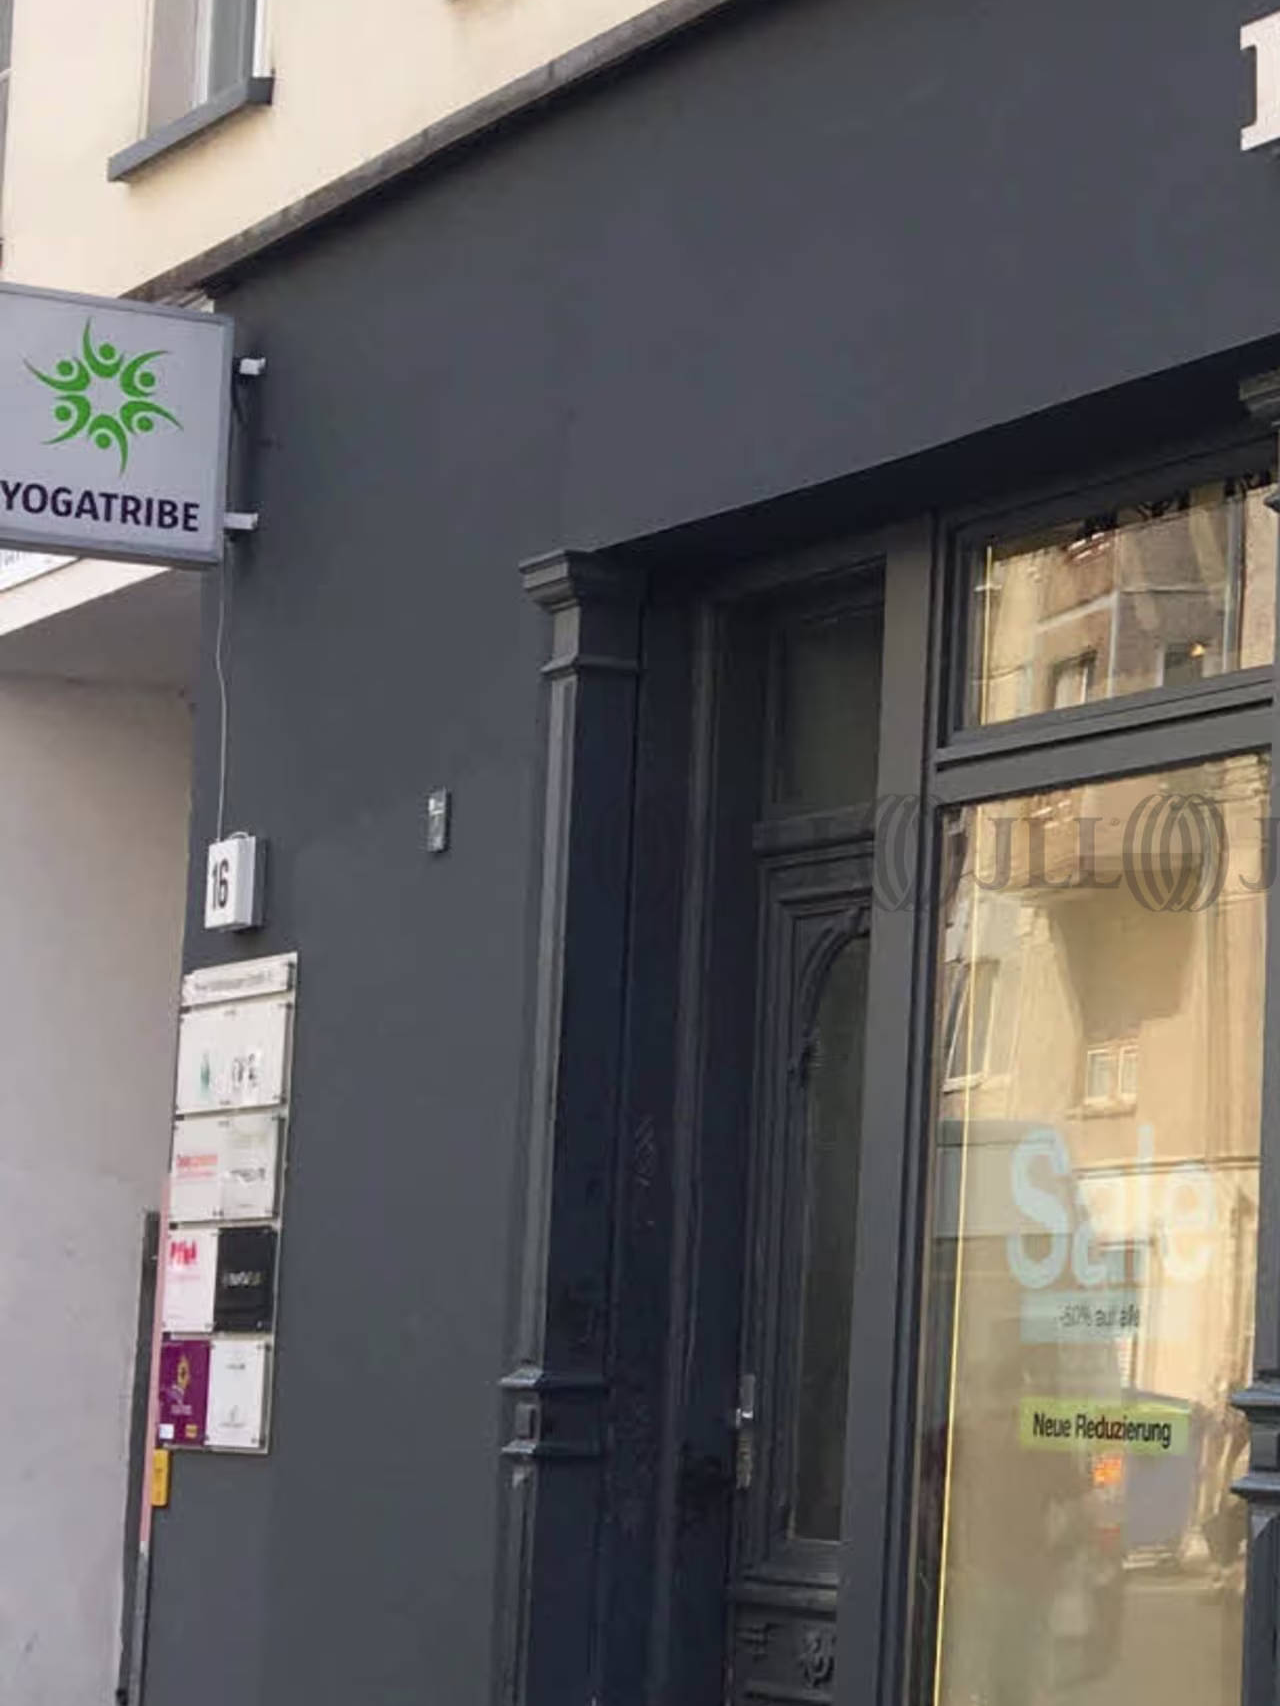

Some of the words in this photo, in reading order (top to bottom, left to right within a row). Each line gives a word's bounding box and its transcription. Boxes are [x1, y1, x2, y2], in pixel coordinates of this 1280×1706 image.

[0, 479, 200, 533] YOGATRIBE
[212, 858, 229, 910] 16
[1032, 1411, 1072, 1439] Neue
[1075, 1413, 1173, 1450] Reduzierung
